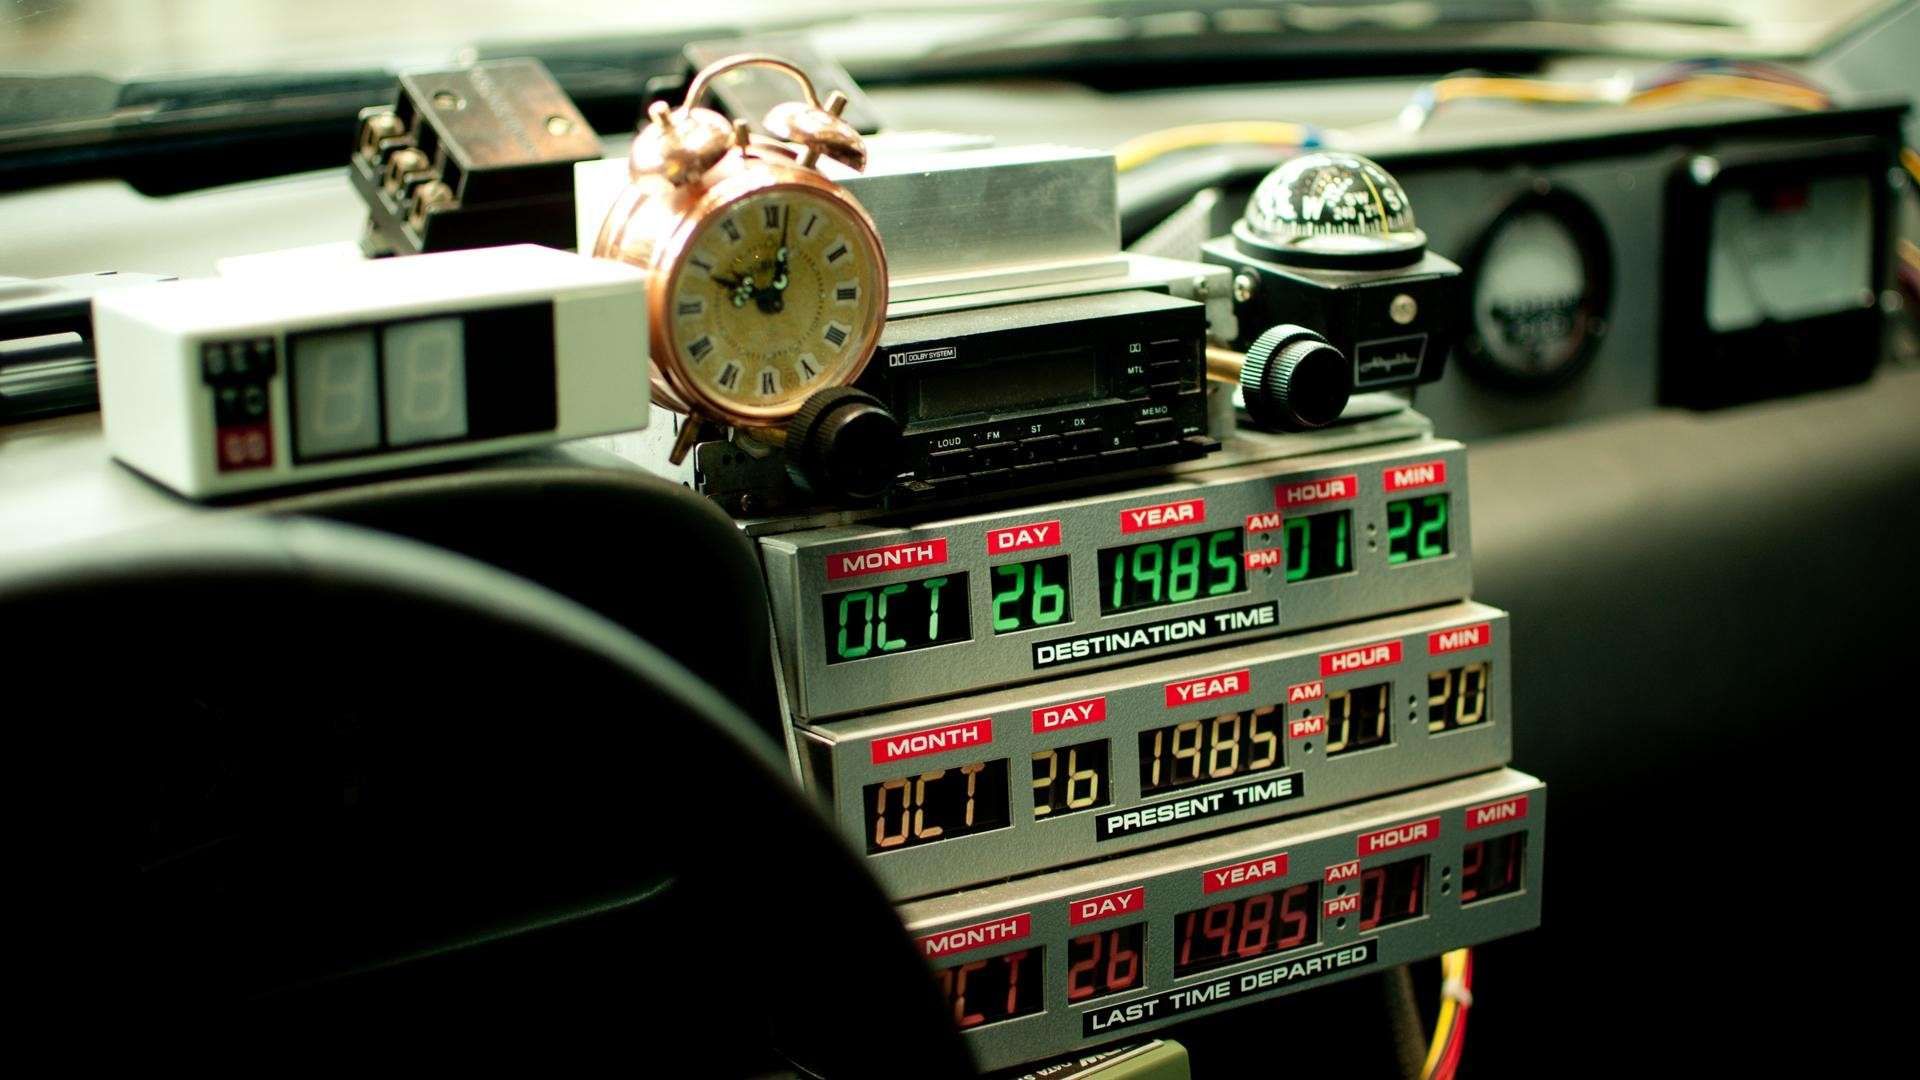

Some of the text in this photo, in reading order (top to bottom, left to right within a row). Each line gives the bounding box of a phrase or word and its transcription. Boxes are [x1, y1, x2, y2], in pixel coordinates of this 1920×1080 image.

[929, 350, 953, 359] SYSTEM
[1127, 366, 1144, 374] MTL
[1074, 418, 1085, 426] DX
[1142, 406, 1168, 416] MEMO
[986, 431, 1000, 440] FM
[1031, 425, 1042, 433] ST
[937, 437, 962, 448] LOUD
[1394, 467, 1435, 485] MIN
[1287, 480, 1346, 503] HOUR
[1131, 505, 1194, 528] YEAR
[1249, 515, 1281, 530] AM
[998, 526, 1049, 549] DAY
[1388, 494, 1447, 565] 22
[842, 545, 933, 573] MONTH
[1112, 530, 1238, 609] 1985
[1249, 552, 1279, 567] PM
[993, 563, 1064, 631] 26
[838, 577, 948, 658] OCT
[1037, 606, 1275, 664] DESTINATION TIME
[1439, 629, 1479, 650] MIN
[1332, 647, 1390, 671] HOUR
[1176, 676, 1239, 699] YEAR
[1290, 683, 1322, 698] AM
[1043, 704, 1095, 728] DAY
[1291, 718, 1322, 734] PM
[887, 726, 979, 758] MONTH
[1152, 705, 1278, 787] 1985
[875, 762, 985, 848] OCT
[1107, 779, 1293, 834] PRESENT TIME
[1476, 801, 1517, 824] MIN
[1370, 823, 1428, 851] HOUR
[1216, 860, 1277, 886] YEAR
[1328, 863, 1358, 882] AM
[1082, 894, 1132, 918] DAY
[1328, 898, 1357, 914] PM
[925, 920, 1017, 955] MONTH
[1182, 886, 1310, 966] 1985
[1068, 931, 1138, 1000] 26
[1092, 945, 1368, 1030] LAST TIME DEPARTED
